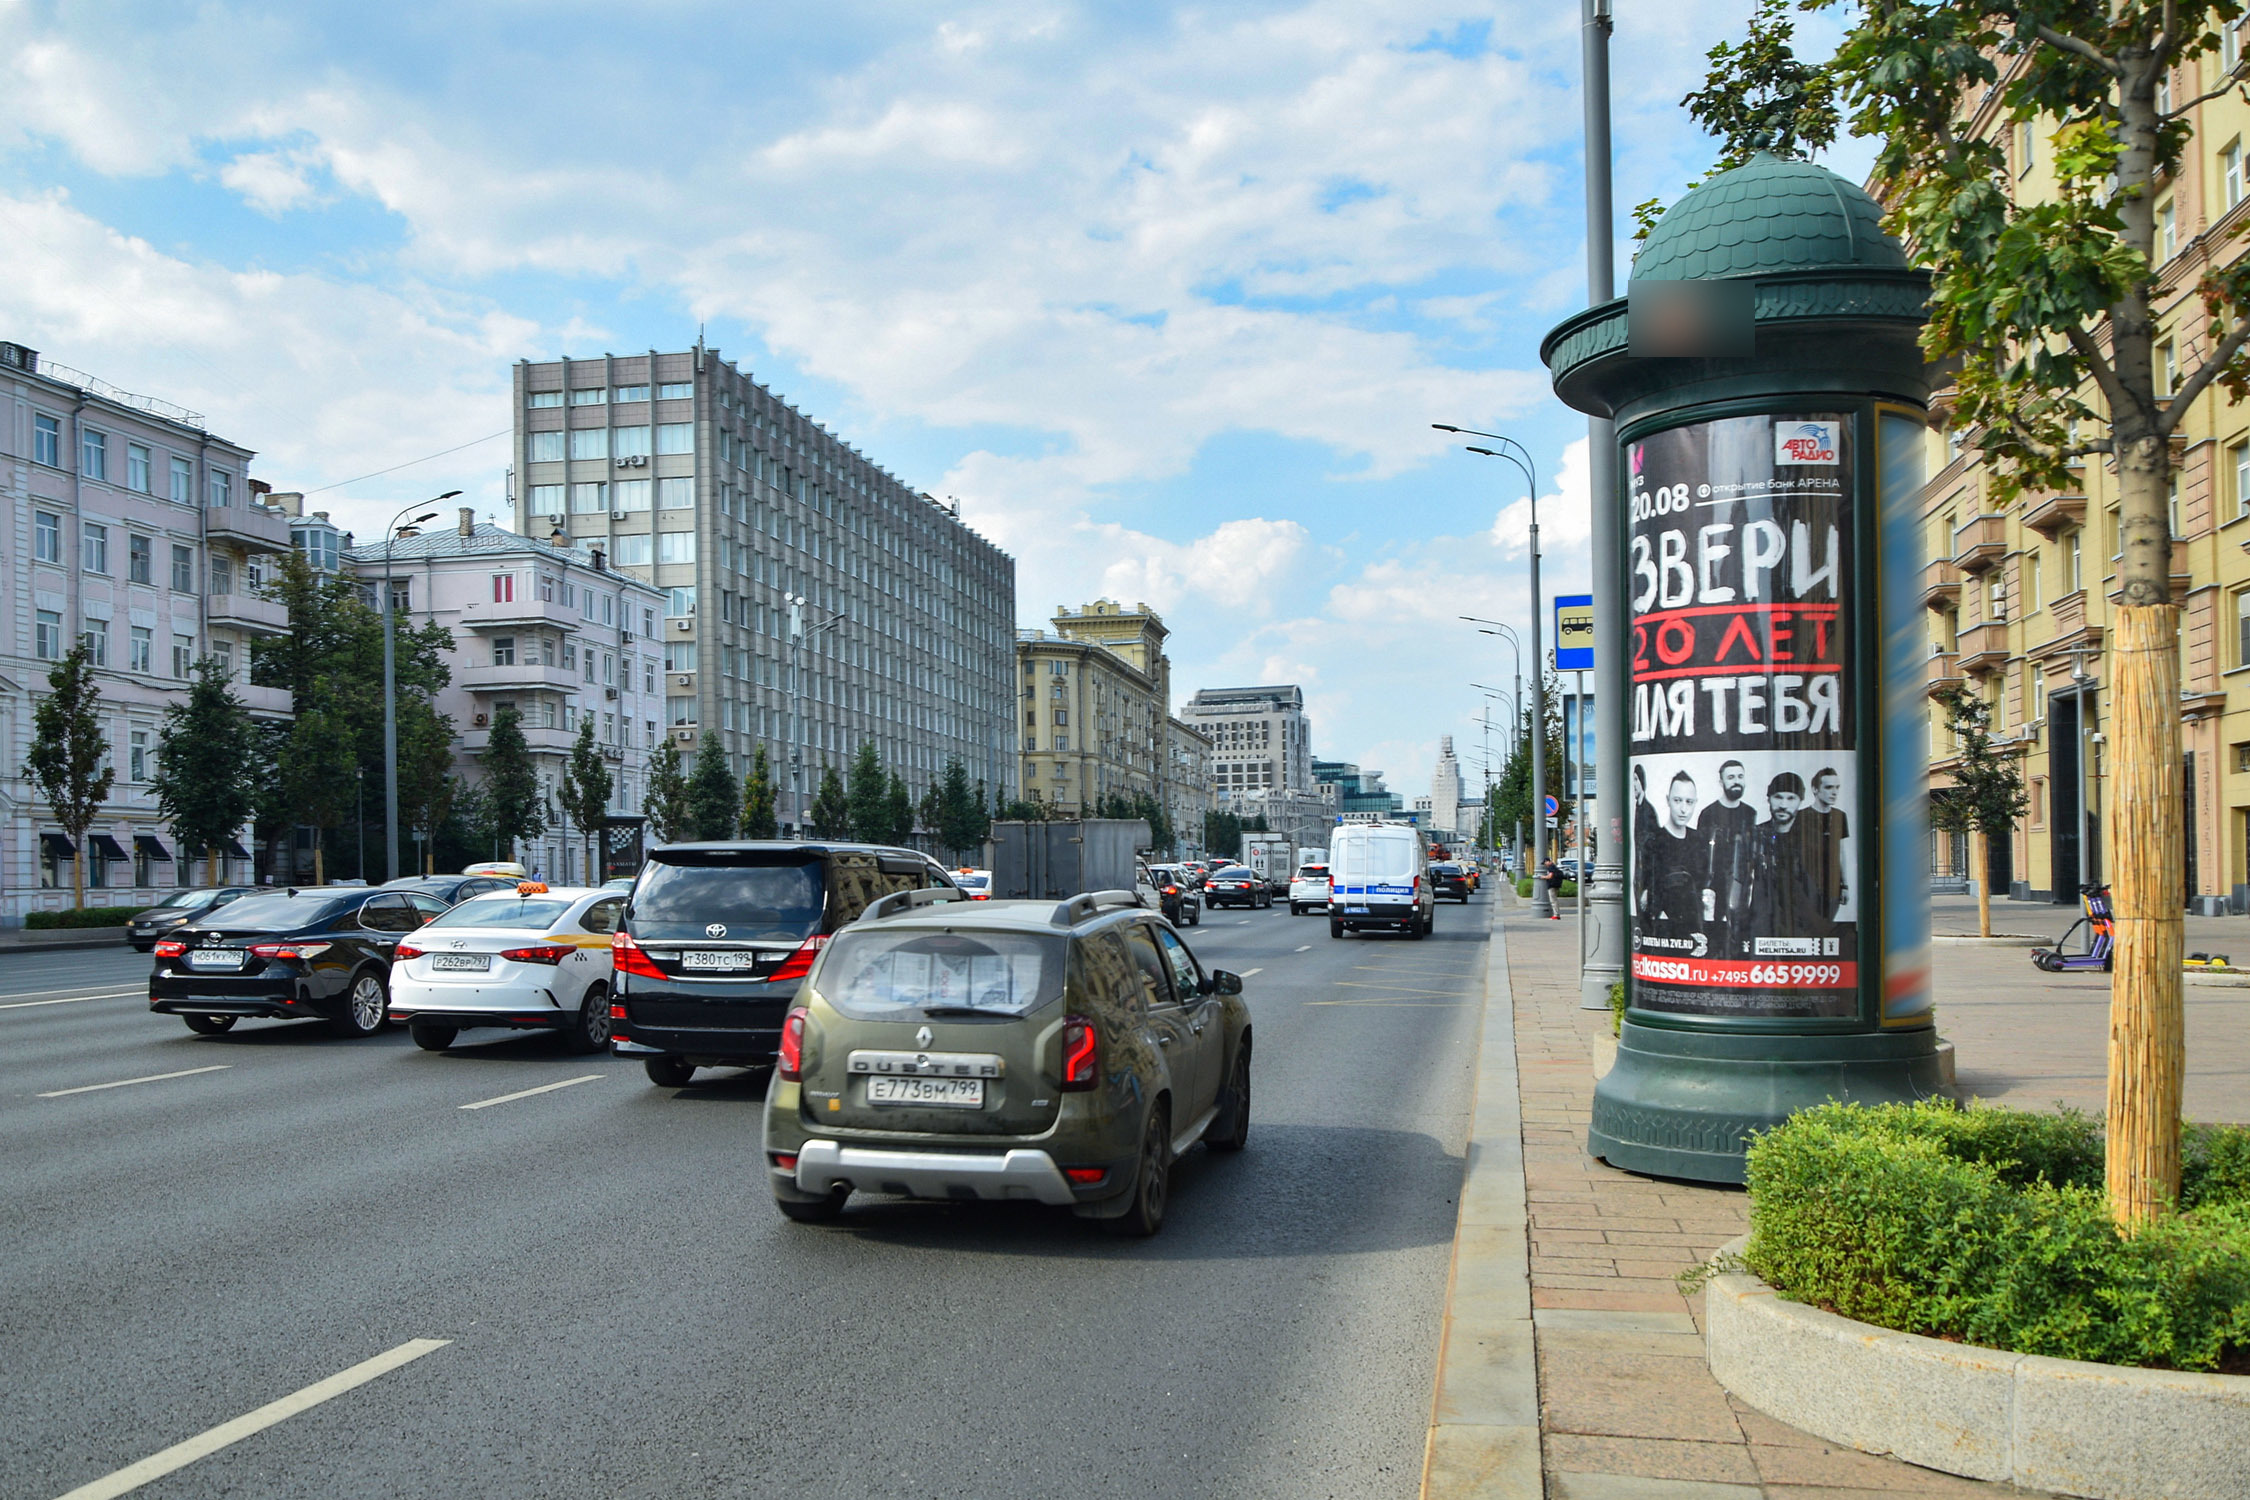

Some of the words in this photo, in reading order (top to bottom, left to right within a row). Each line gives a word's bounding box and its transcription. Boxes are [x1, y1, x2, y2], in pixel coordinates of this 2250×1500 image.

[1782, 439, 1817, 450] АВТО
[1792, 450, 1834, 461] РАДИО
[1712, 481, 1765, 494] открытие
[1768, 479, 1795, 489] банк
[1798, 478, 1840, 488] АРЕНА
[1631, 483, 1690, 524] 20.08
[1631, 517, 1839, 614] ЗВЕРИ
[1633, 617, 1696, 671] 20
[1715, 612, 1837, 662] ЛЕТ
[1632, 679, 1695, 742] ДЛЯ
[1701, 674, 1840, 735] ТЕБЯ
[1661, 938, 1670, 948] НА
[1670, 939, 1693, 950] ZVE.RU
[1633, 956, 1708, 982] redkassa.ru
[1711, 971, 1748, 983] +7495
[854, 1061, 996, 1076] DUSTER
